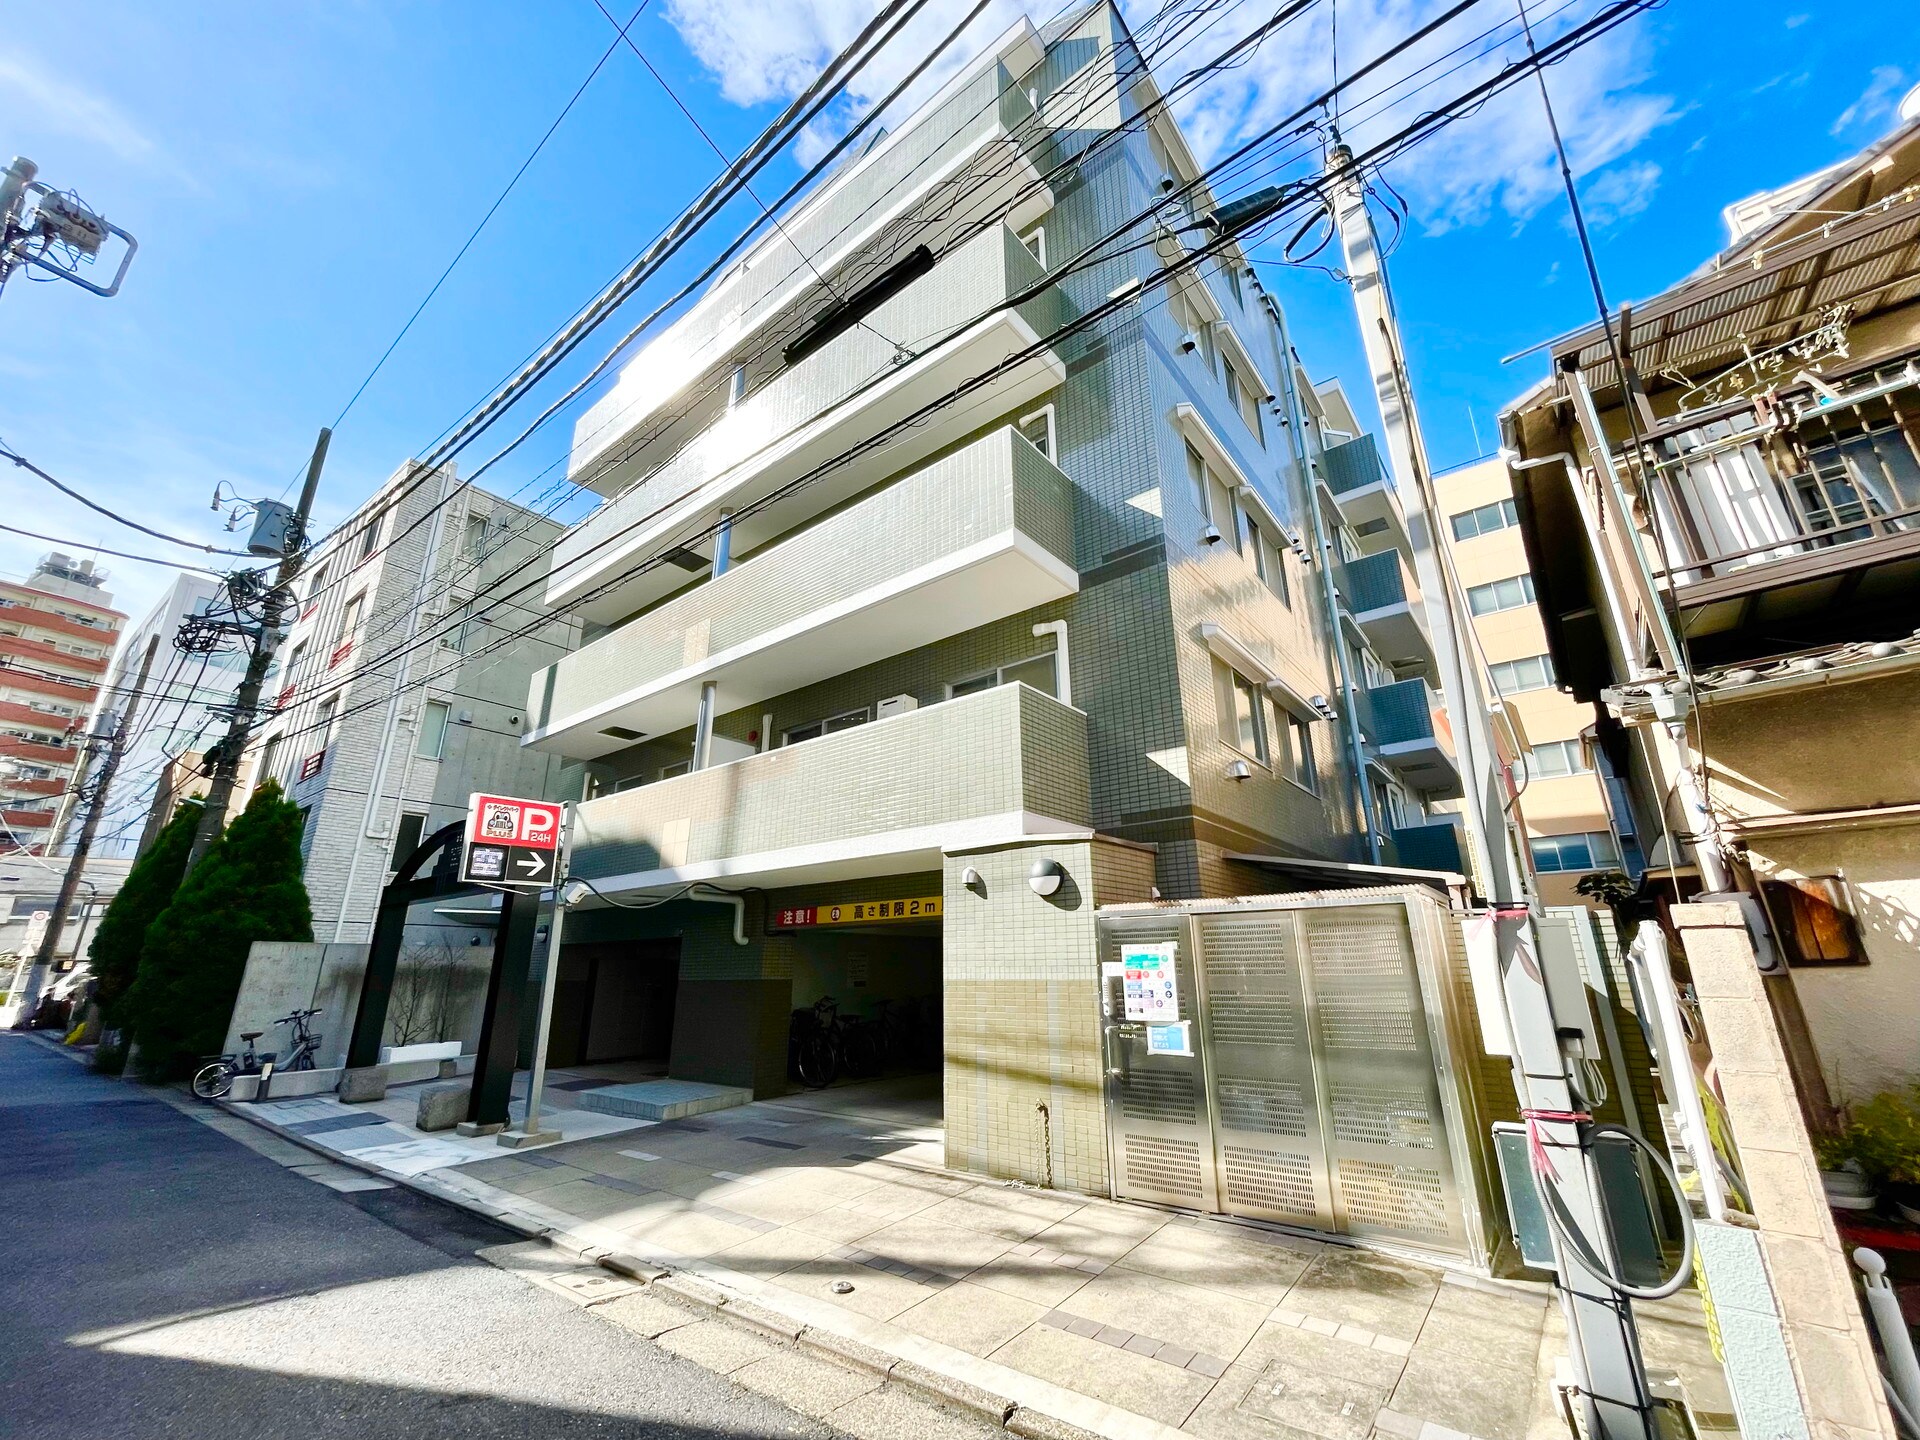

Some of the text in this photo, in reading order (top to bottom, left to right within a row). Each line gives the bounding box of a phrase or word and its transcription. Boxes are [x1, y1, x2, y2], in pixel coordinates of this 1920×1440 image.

[521, 807, 554, 841] P
[486, 829, 513, 838] PLUS
[530, 832, 552, 843] 24H
